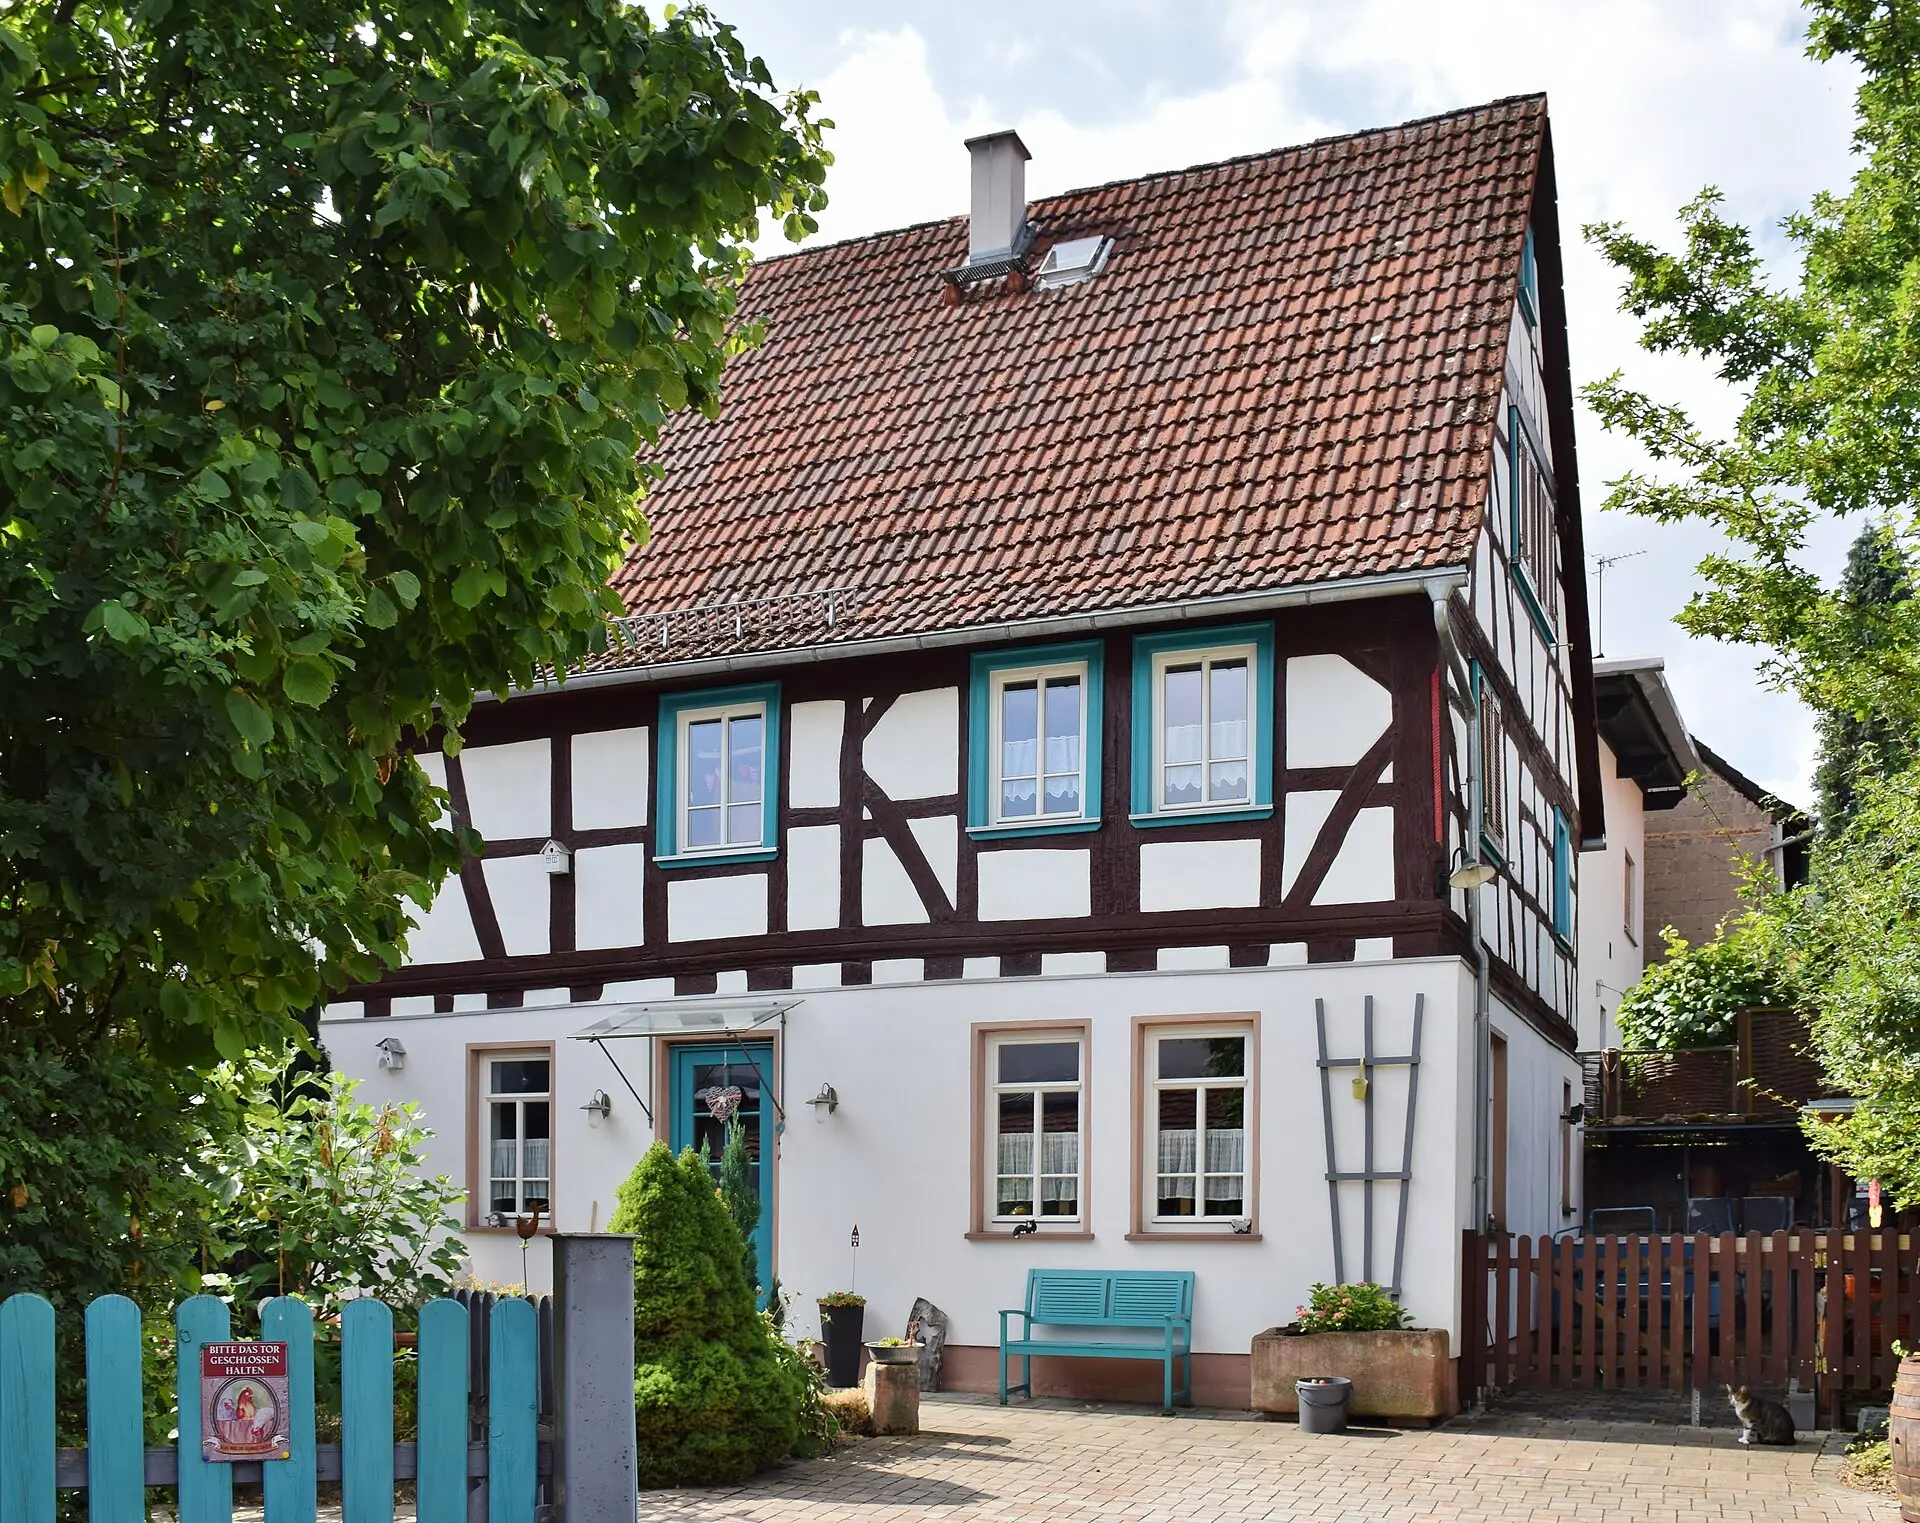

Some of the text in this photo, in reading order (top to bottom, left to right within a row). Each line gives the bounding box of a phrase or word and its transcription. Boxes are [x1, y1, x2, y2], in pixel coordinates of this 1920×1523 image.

[209, 1345, 280, 1354] BITTE DAS TOR
[210, 1356, 280, 1364] GESCHLOSSEN
[225, 1366, 265, 1375] HALTEN
